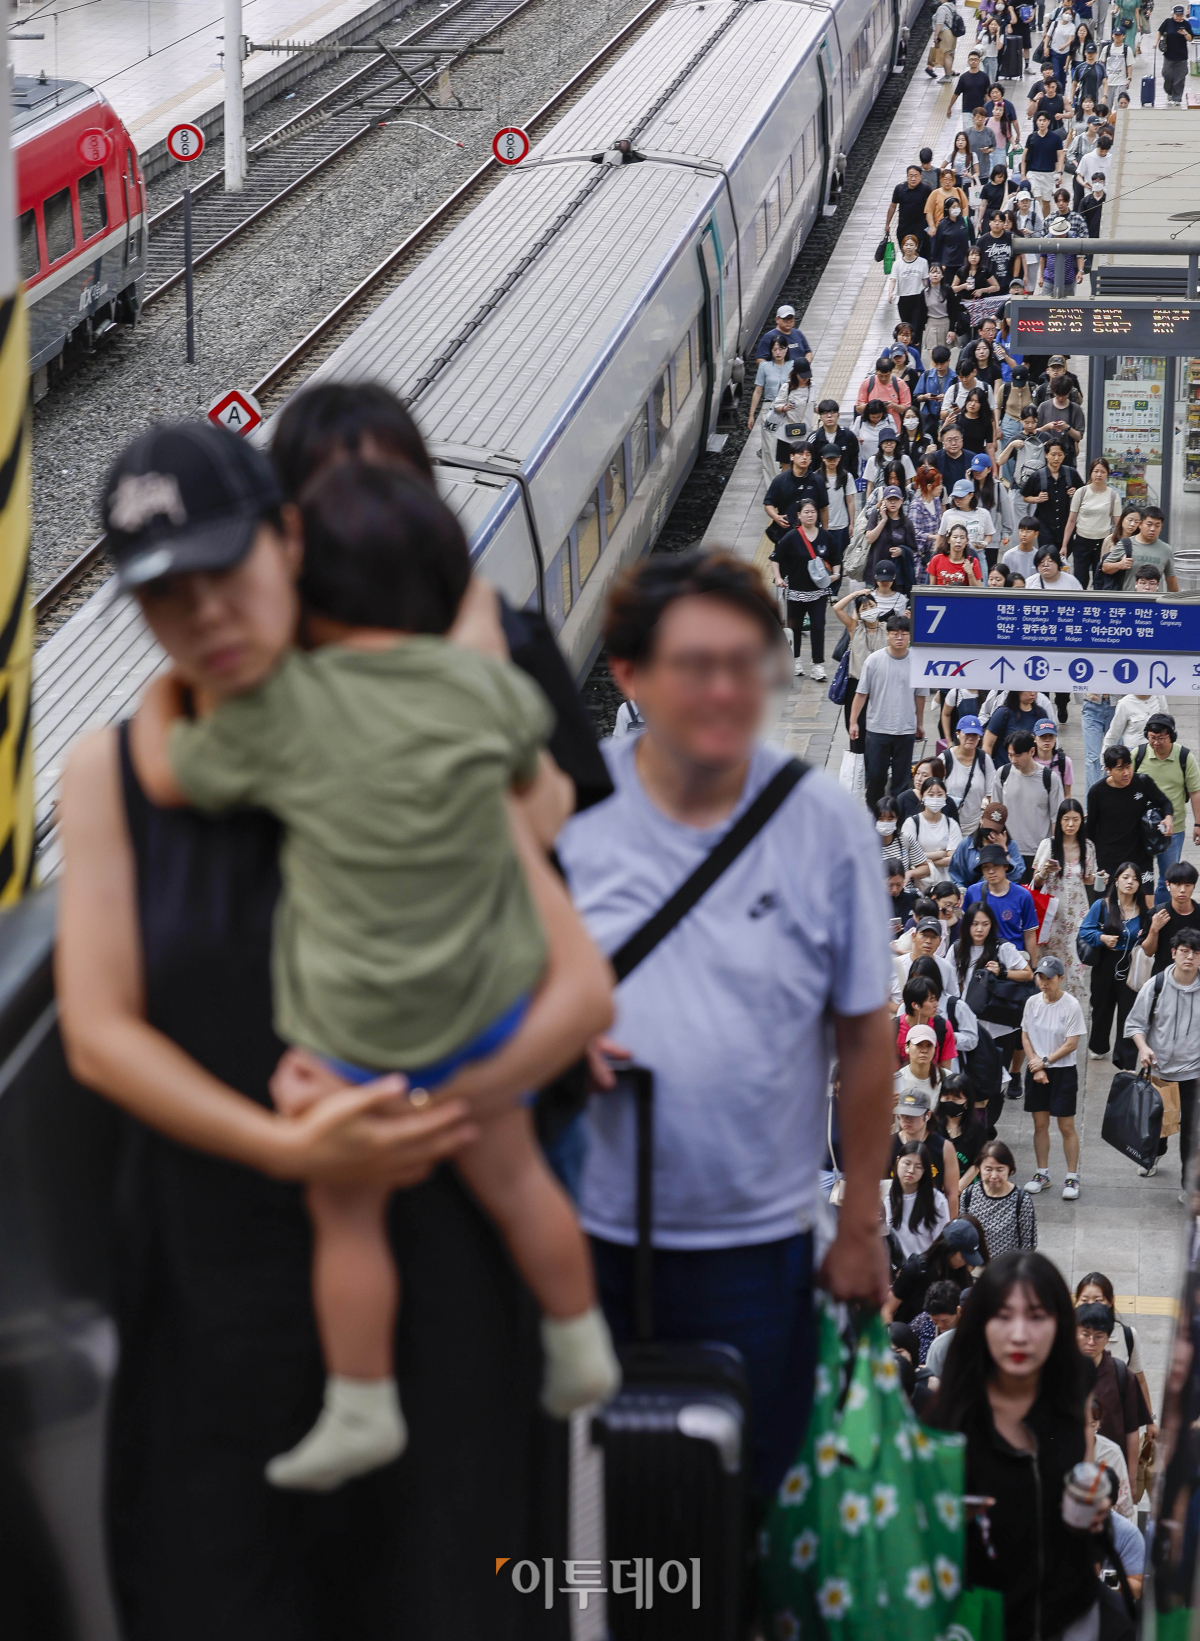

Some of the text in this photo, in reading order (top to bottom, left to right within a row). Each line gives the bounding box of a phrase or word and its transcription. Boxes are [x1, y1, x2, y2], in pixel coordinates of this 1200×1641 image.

[180, 130, 189, 142] 8
[506, 133, 515, 146] 8
[507, 147, 515, 159] 6
[227, 406, 242, 424] A
[997, 604, 1015, 615] 대전
[1022, 605, 1049, 616] 동대구
[1057, 606, 1076, 617] 부산
[1082, 606, 1102, 618] 포항
[1108, 607, 1127, 618] 진주
[1134, 608, 1153, 619] 마산
[926, 605, 947, 634] 7
[1021, 623, 1058, 635] 광주송정
[1064, 624, 1083, 635] 목포
[1090, 625, 1133, 637] 여수EXPO
[1136, 627, 1155, 638] 방면
[923, 658, 979, 677] KTX
[1025, 659, 1130, 680] 18 9 1
